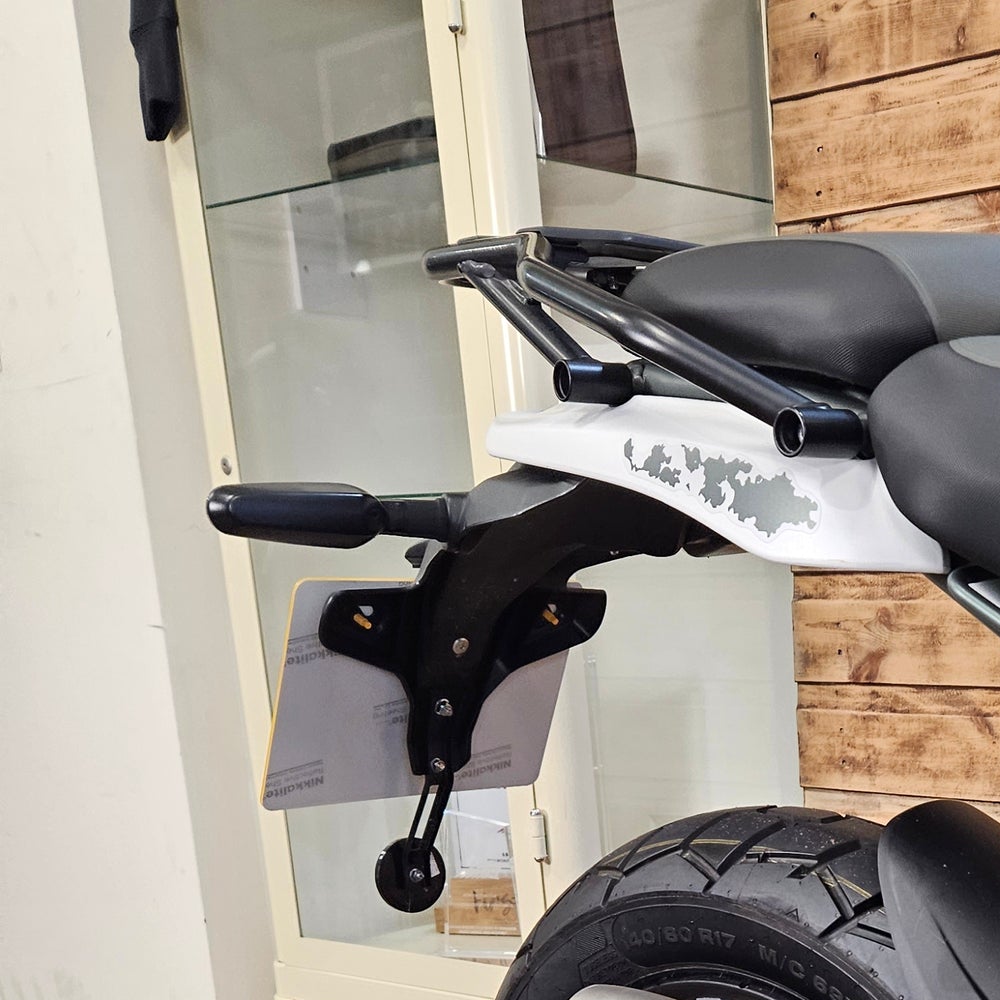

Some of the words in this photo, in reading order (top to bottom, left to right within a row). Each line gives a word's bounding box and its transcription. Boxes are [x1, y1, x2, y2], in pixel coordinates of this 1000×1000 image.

[264, 776, 325, 799] Nikkalite
[697, 926, 737, 949] R17
[758, 943, 806, 980] M/C
